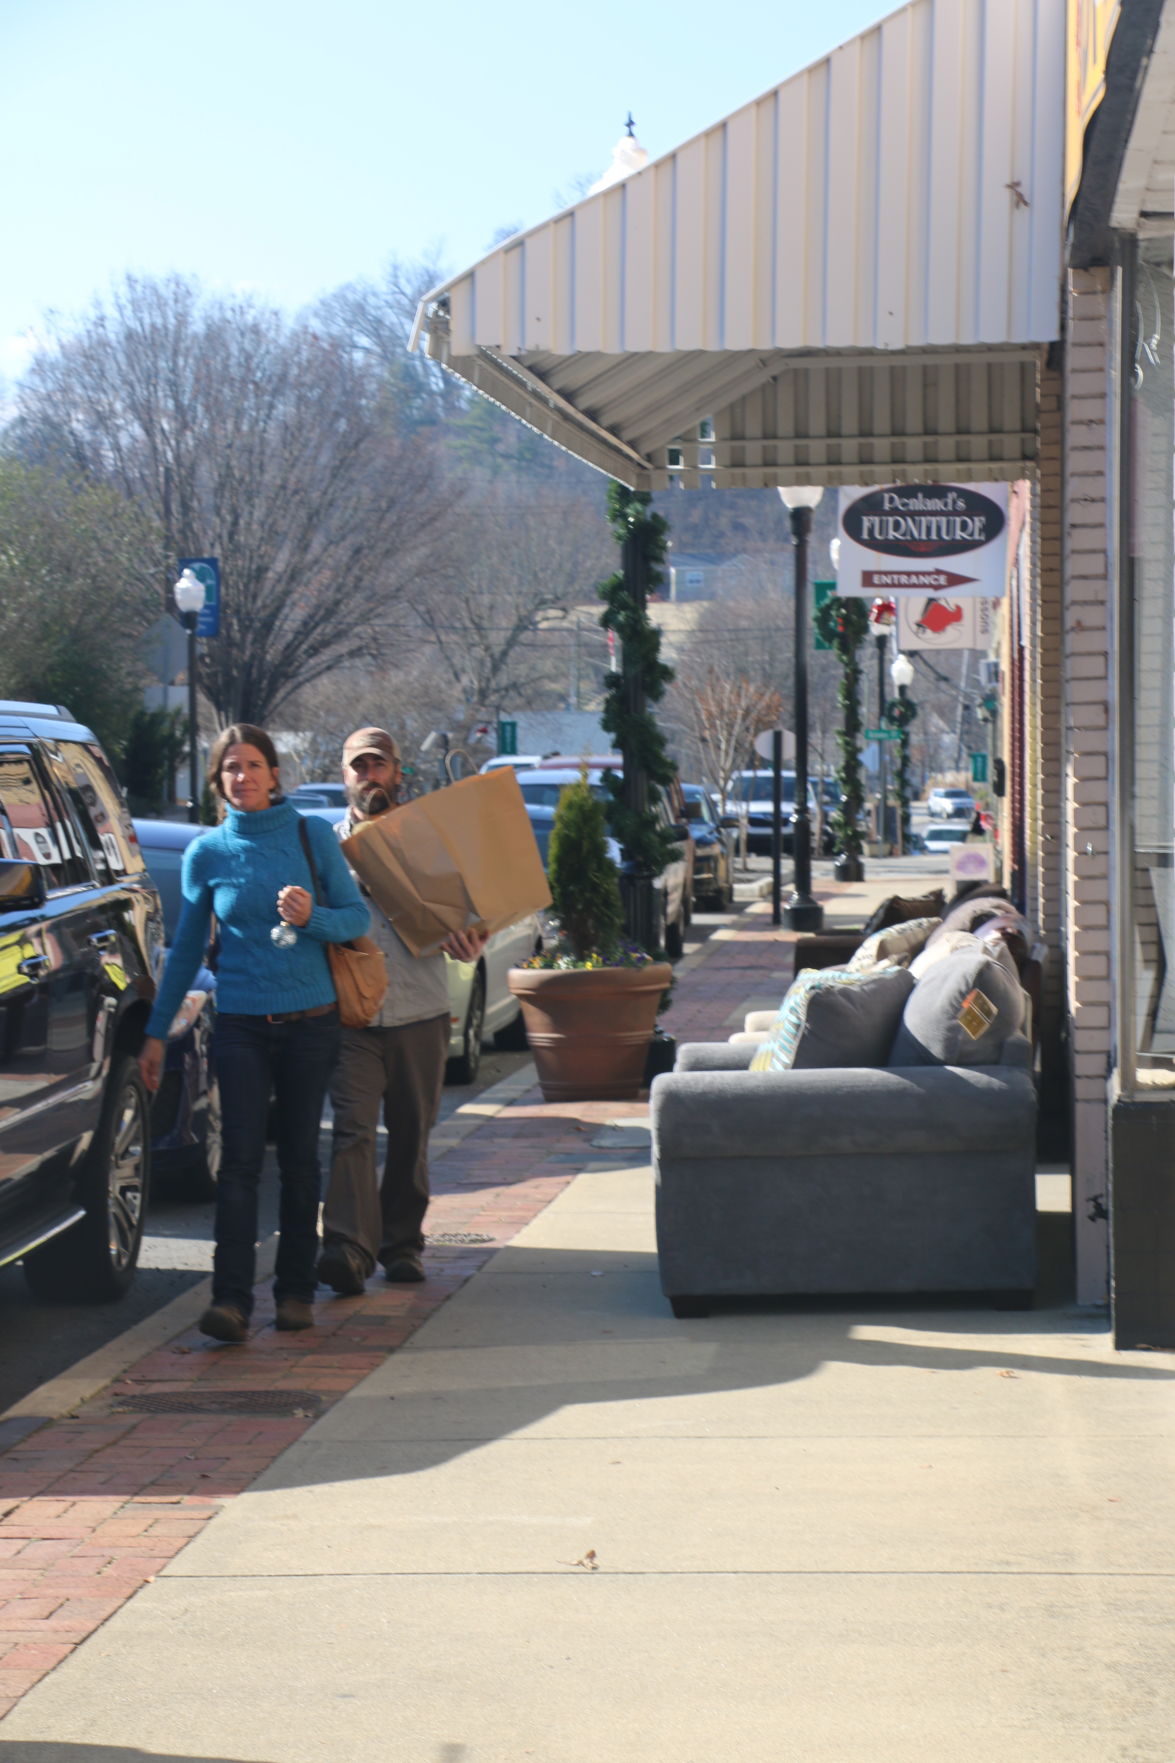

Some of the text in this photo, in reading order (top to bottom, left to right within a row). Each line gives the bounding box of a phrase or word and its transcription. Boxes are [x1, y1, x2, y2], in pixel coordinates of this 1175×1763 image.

[882, 491, 967, 511] Penland's
[861, 515, 986, 541] FURNITURE
[873, 574, 948, 586] ENTRANCE
